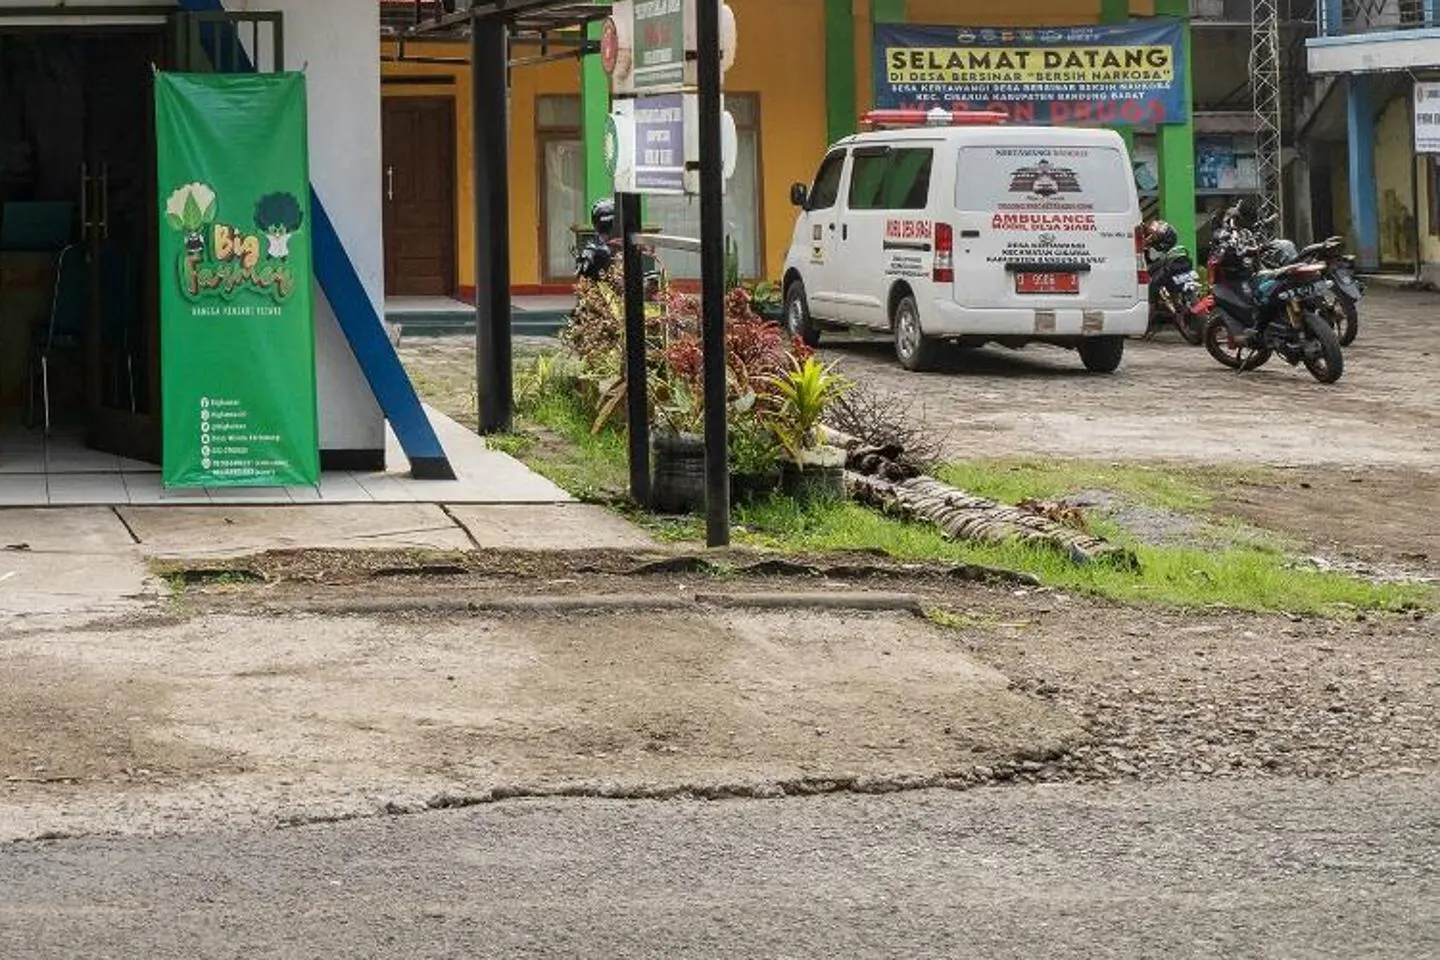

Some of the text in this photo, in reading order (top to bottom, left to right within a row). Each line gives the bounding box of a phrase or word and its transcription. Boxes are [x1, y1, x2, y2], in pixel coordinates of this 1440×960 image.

[892, 49, 1168, 69] SELAMAT DATANG
[890, 72, 903, 81] DI
[910, 72, 945, 81] DESA
[952, 72, 1022, 81] BERSINAR
[1049, 98, 1165, 122] DRUGS
[992, 214, 1095, 223] AMBULANCE
[215, 223, 259, 269] Big
